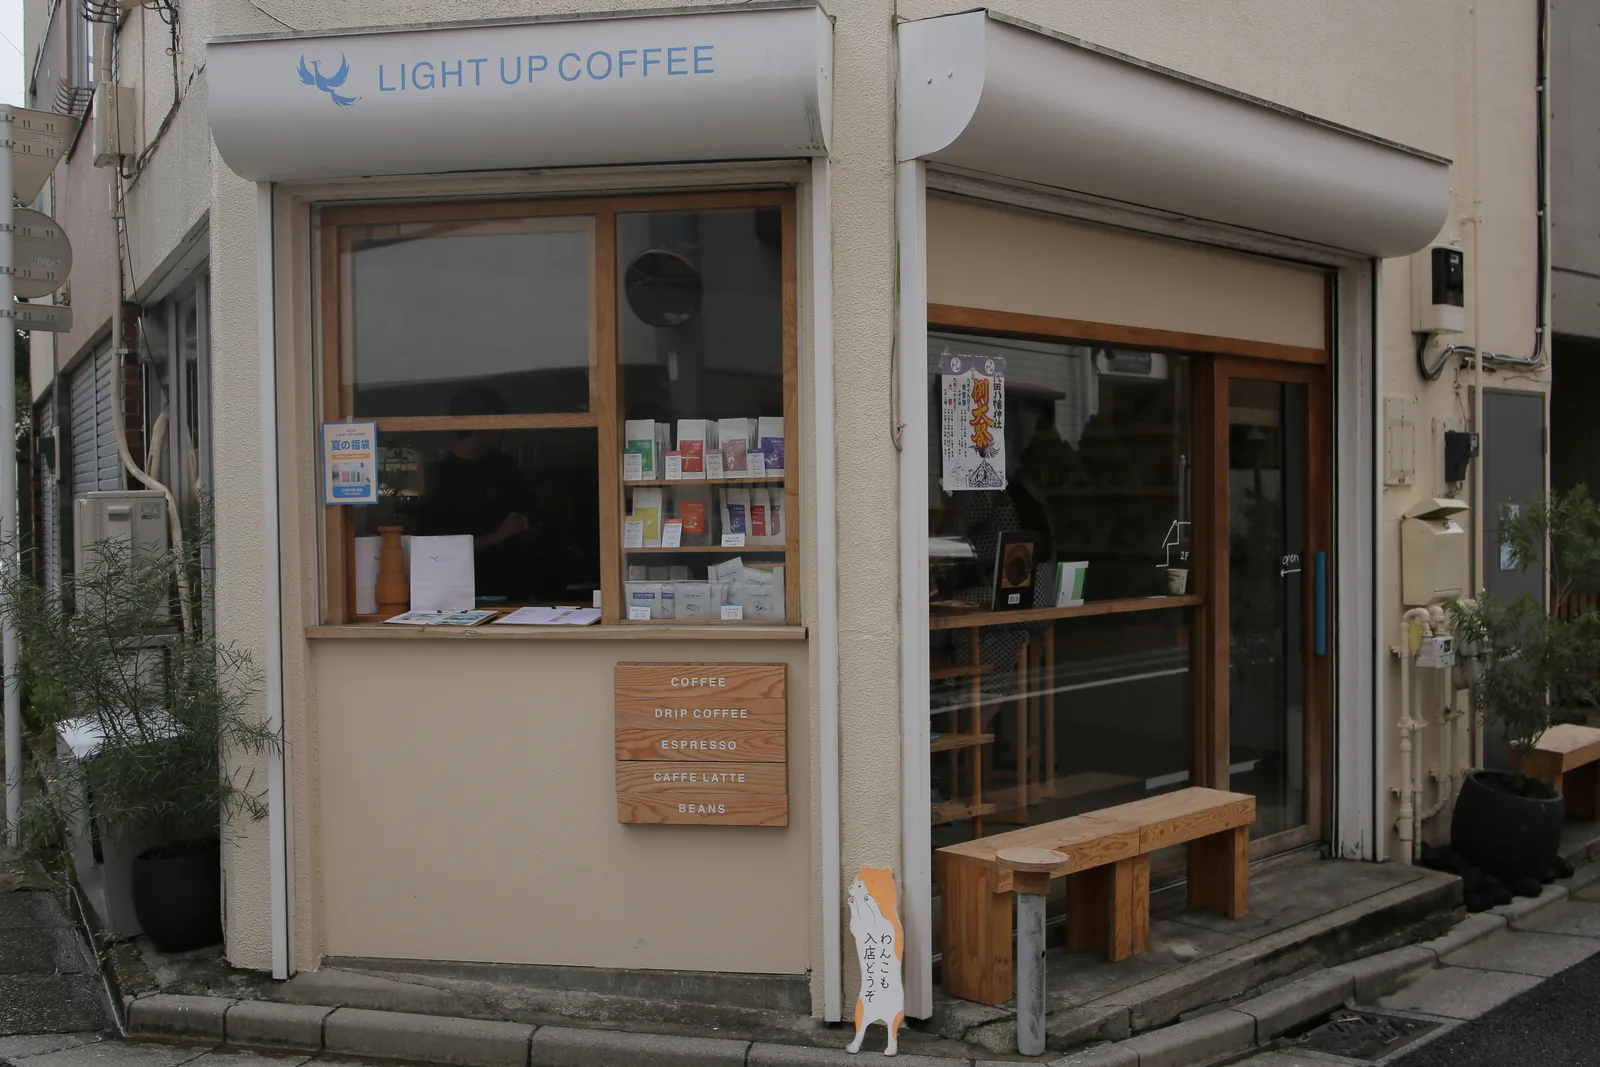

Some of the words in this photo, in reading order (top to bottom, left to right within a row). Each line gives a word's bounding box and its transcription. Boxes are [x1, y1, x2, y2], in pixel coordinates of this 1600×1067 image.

[378, 58, 488, 92] LIGHT
[499, 55, 549, 85] UP
[558, 45, 715, 82] COFFEE
[992, 372, 1004, 430] 代田八幡神社
[969, 378, 995, 449] 例大祭
[331, 439, 370, 450] 夏の福袋
[1180, 551, 1189, 561] 2F
[1282, 554, 1300, 565] open
[671, 677, 726, 687] COFFEE
[654, 708, 688, 718] DRIP
[693, 709, 748, 719] COFFEE
[661, 740, 737, 750] ESPRESSO
[653, 772, 697, 782] CAFFE
[702, 773, 745, 783] LATTE
[678, 804, 726, 814] BEANS
[879, 932, 893, 990] わんこも
[863, 932, 878, 1003] 入店どうぞ
